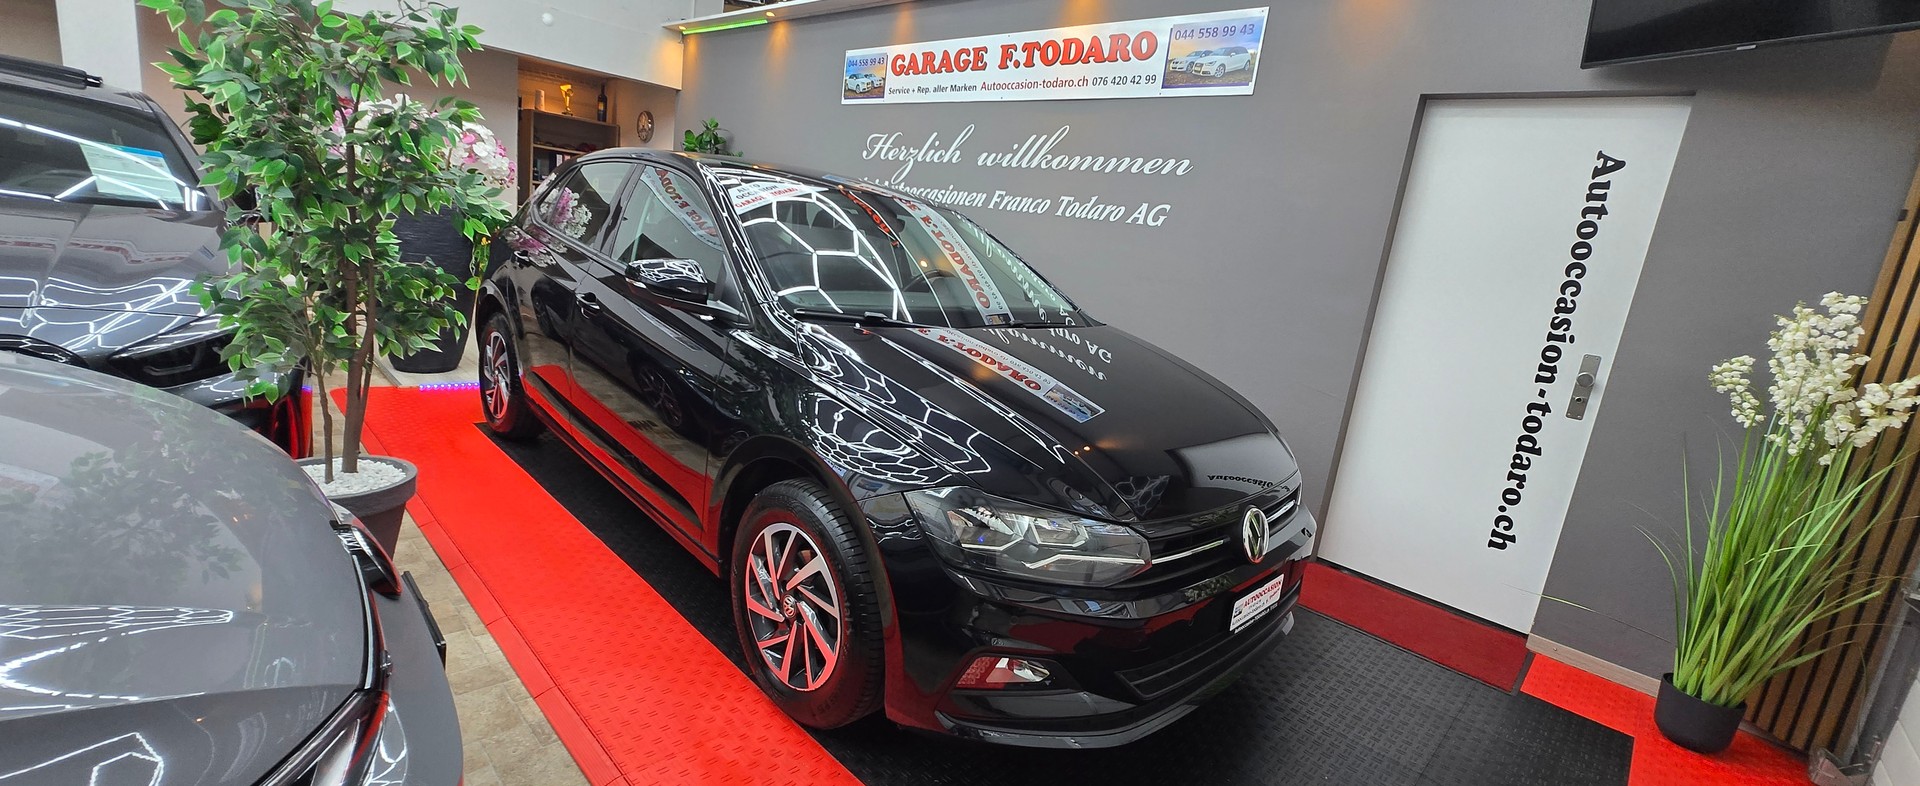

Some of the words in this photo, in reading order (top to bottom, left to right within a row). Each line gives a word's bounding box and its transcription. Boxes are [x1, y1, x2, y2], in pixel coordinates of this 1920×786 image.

[1174, 29, 1195, 41] 044
[1198, 27, 1219, 39] 558
[1222, 25, 1237, 37] 99
[1240, 23, 1255, 35] 43
[891, 46, 988, 77] GARAGE
[998, 31, 1159, 70] F.TODARO
[888, 86, 911, 95] Service
[917, 86, 932, 96] Rep.
[933, 84, 949, 93] aller
[950, 83, 977, 93] Marken
[980, 75, 1089, 91] Autooccasion-todaro.ch
[1092, 76, 1109, 87] 076
[1110, 75, 1128, 86] 420
[1130, 75, 1142, 85] 42
[1144, 74, 1157, 85] 99
[862, 124, 975, 184] Herzlich
[977, 125, 1194, 176] willkommen
[988, 189, 1051, 214] Franco
[1054, 195, 1126, 222] Todaro
[1125, 202, 1171, 228] AG
[1488, 150, 1627, 550] Autooccasion-todaro.ch
